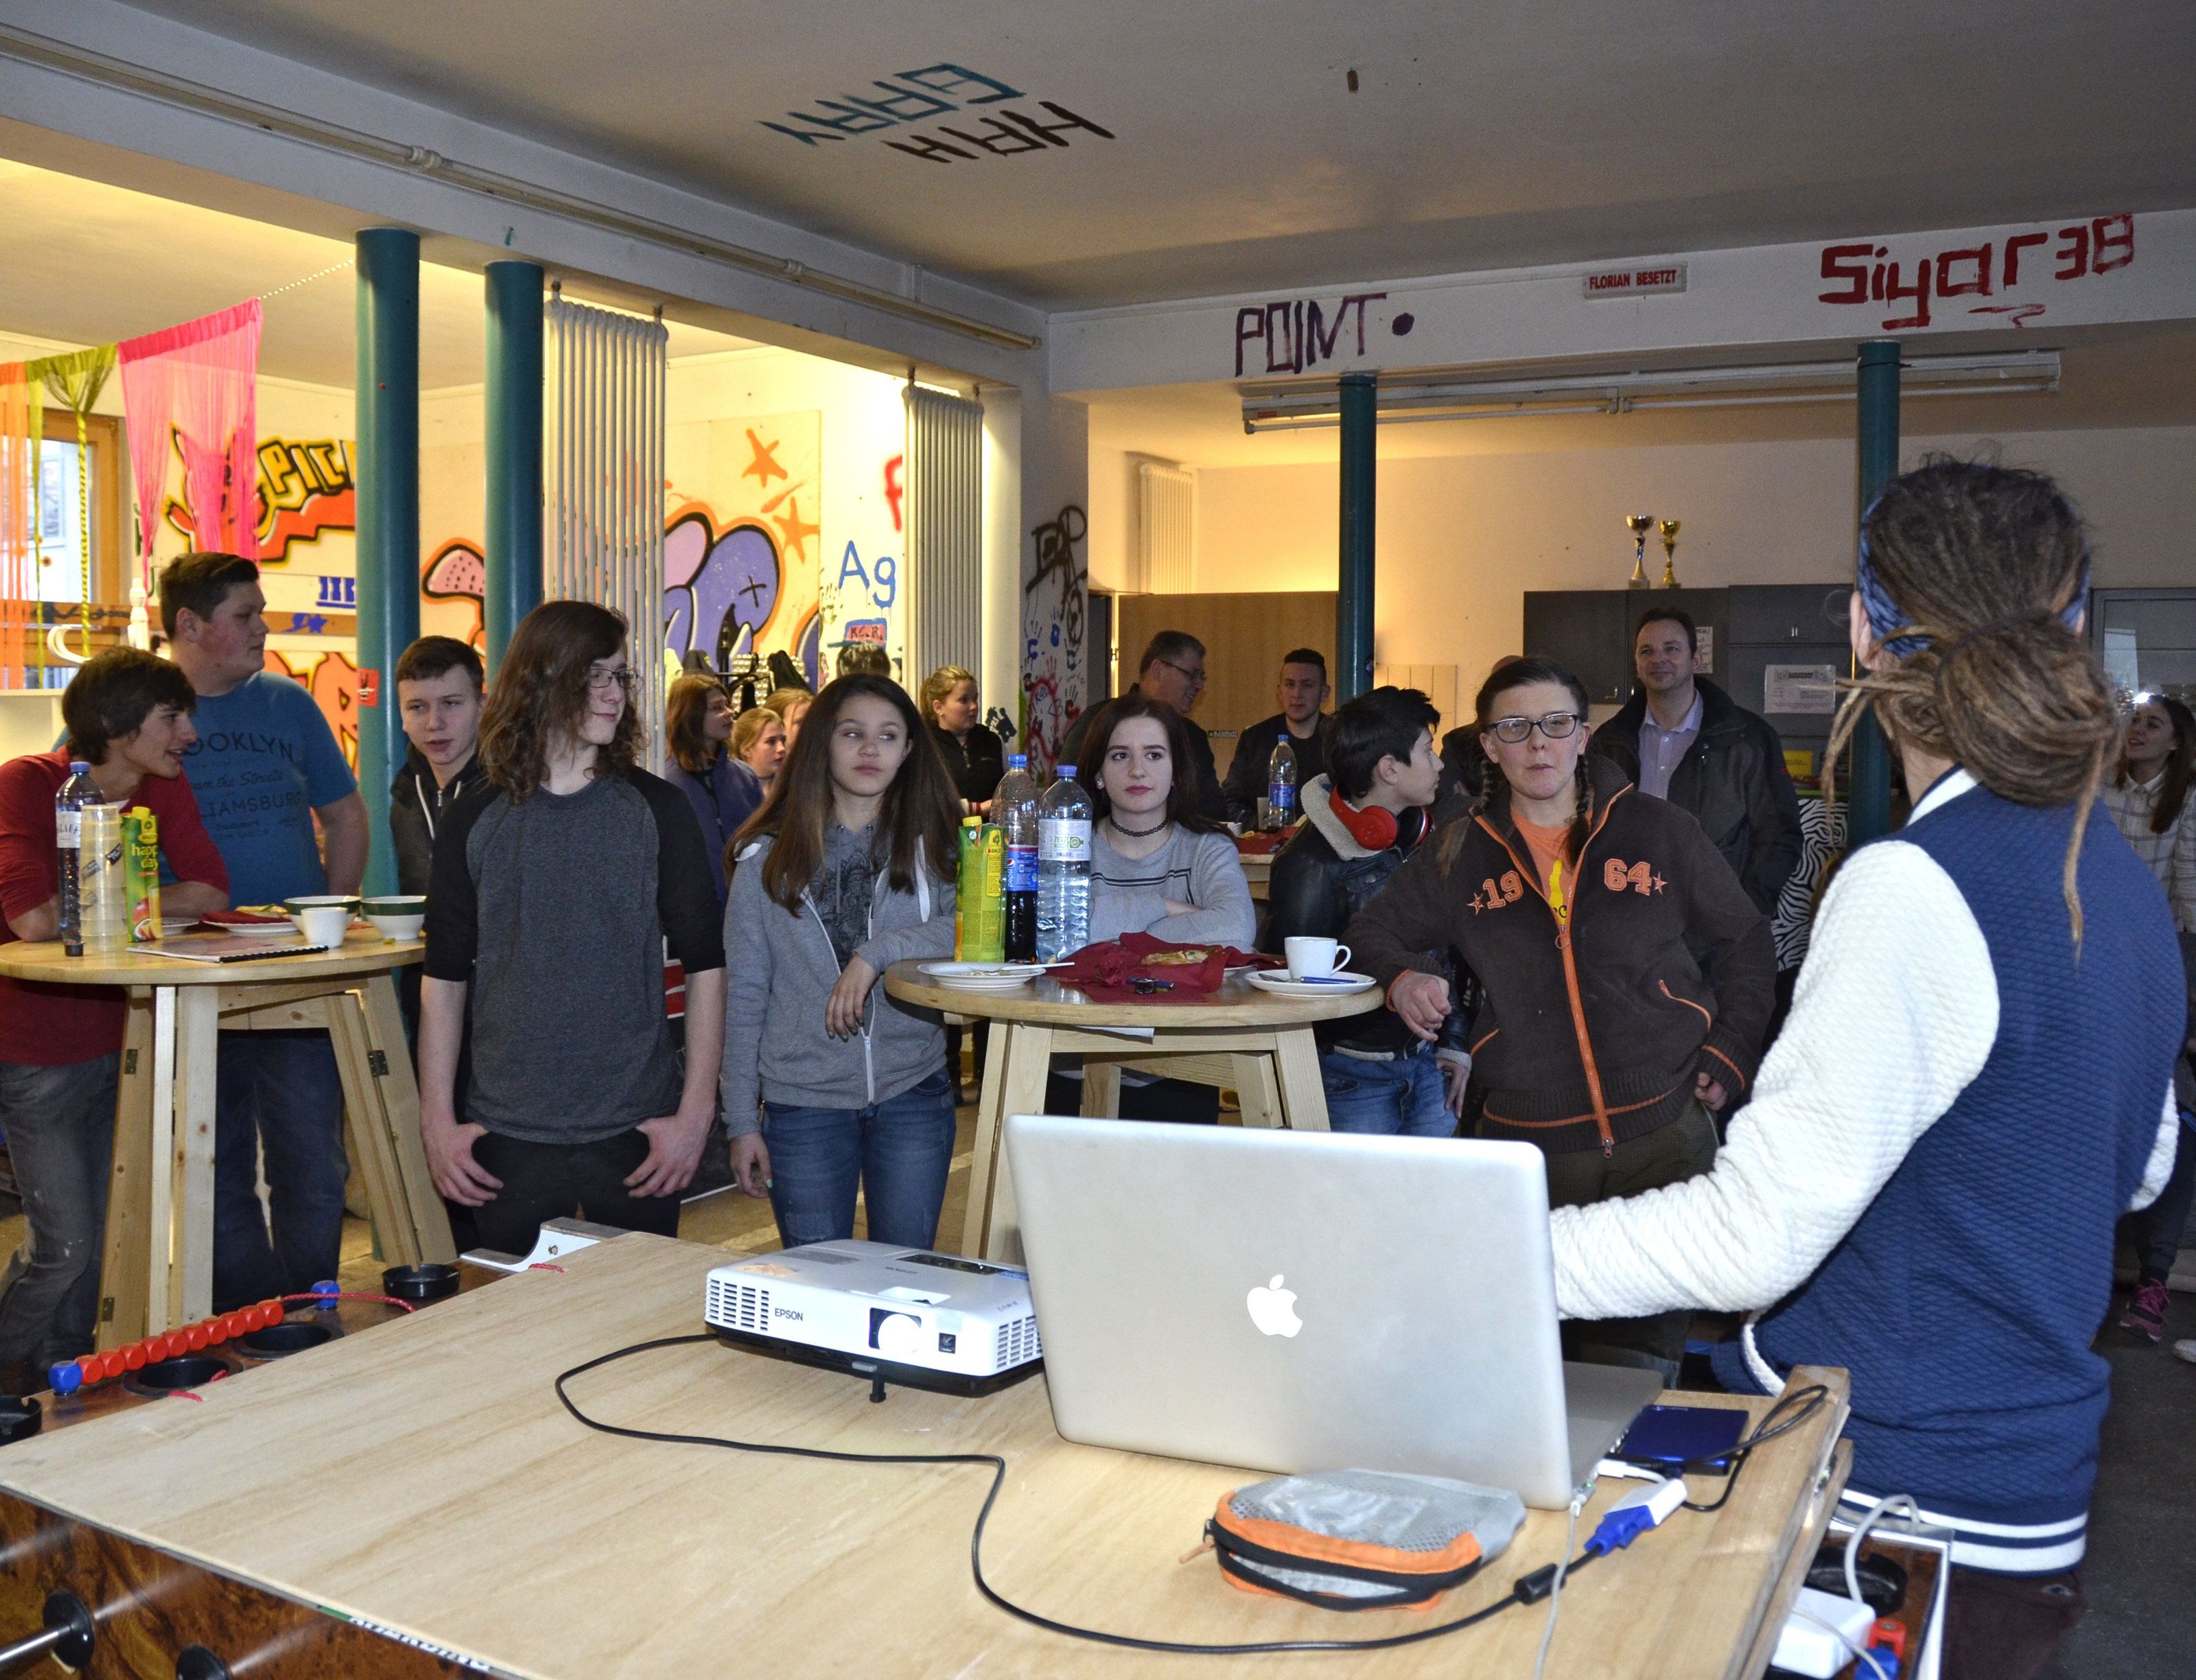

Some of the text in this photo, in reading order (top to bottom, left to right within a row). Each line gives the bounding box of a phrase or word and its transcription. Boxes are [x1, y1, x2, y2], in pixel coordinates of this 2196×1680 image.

[1590, 269, 1677, 290] FLORIAN BESETZT
[1235, 292, 1386, 377] POINT
[838, 540, 896, 609] Ag
[183, 732, 294, 763] OOKLYN
[1483, 858, 1652, 909] 19 64
[775, 1307, 803, 1321] EPSON
